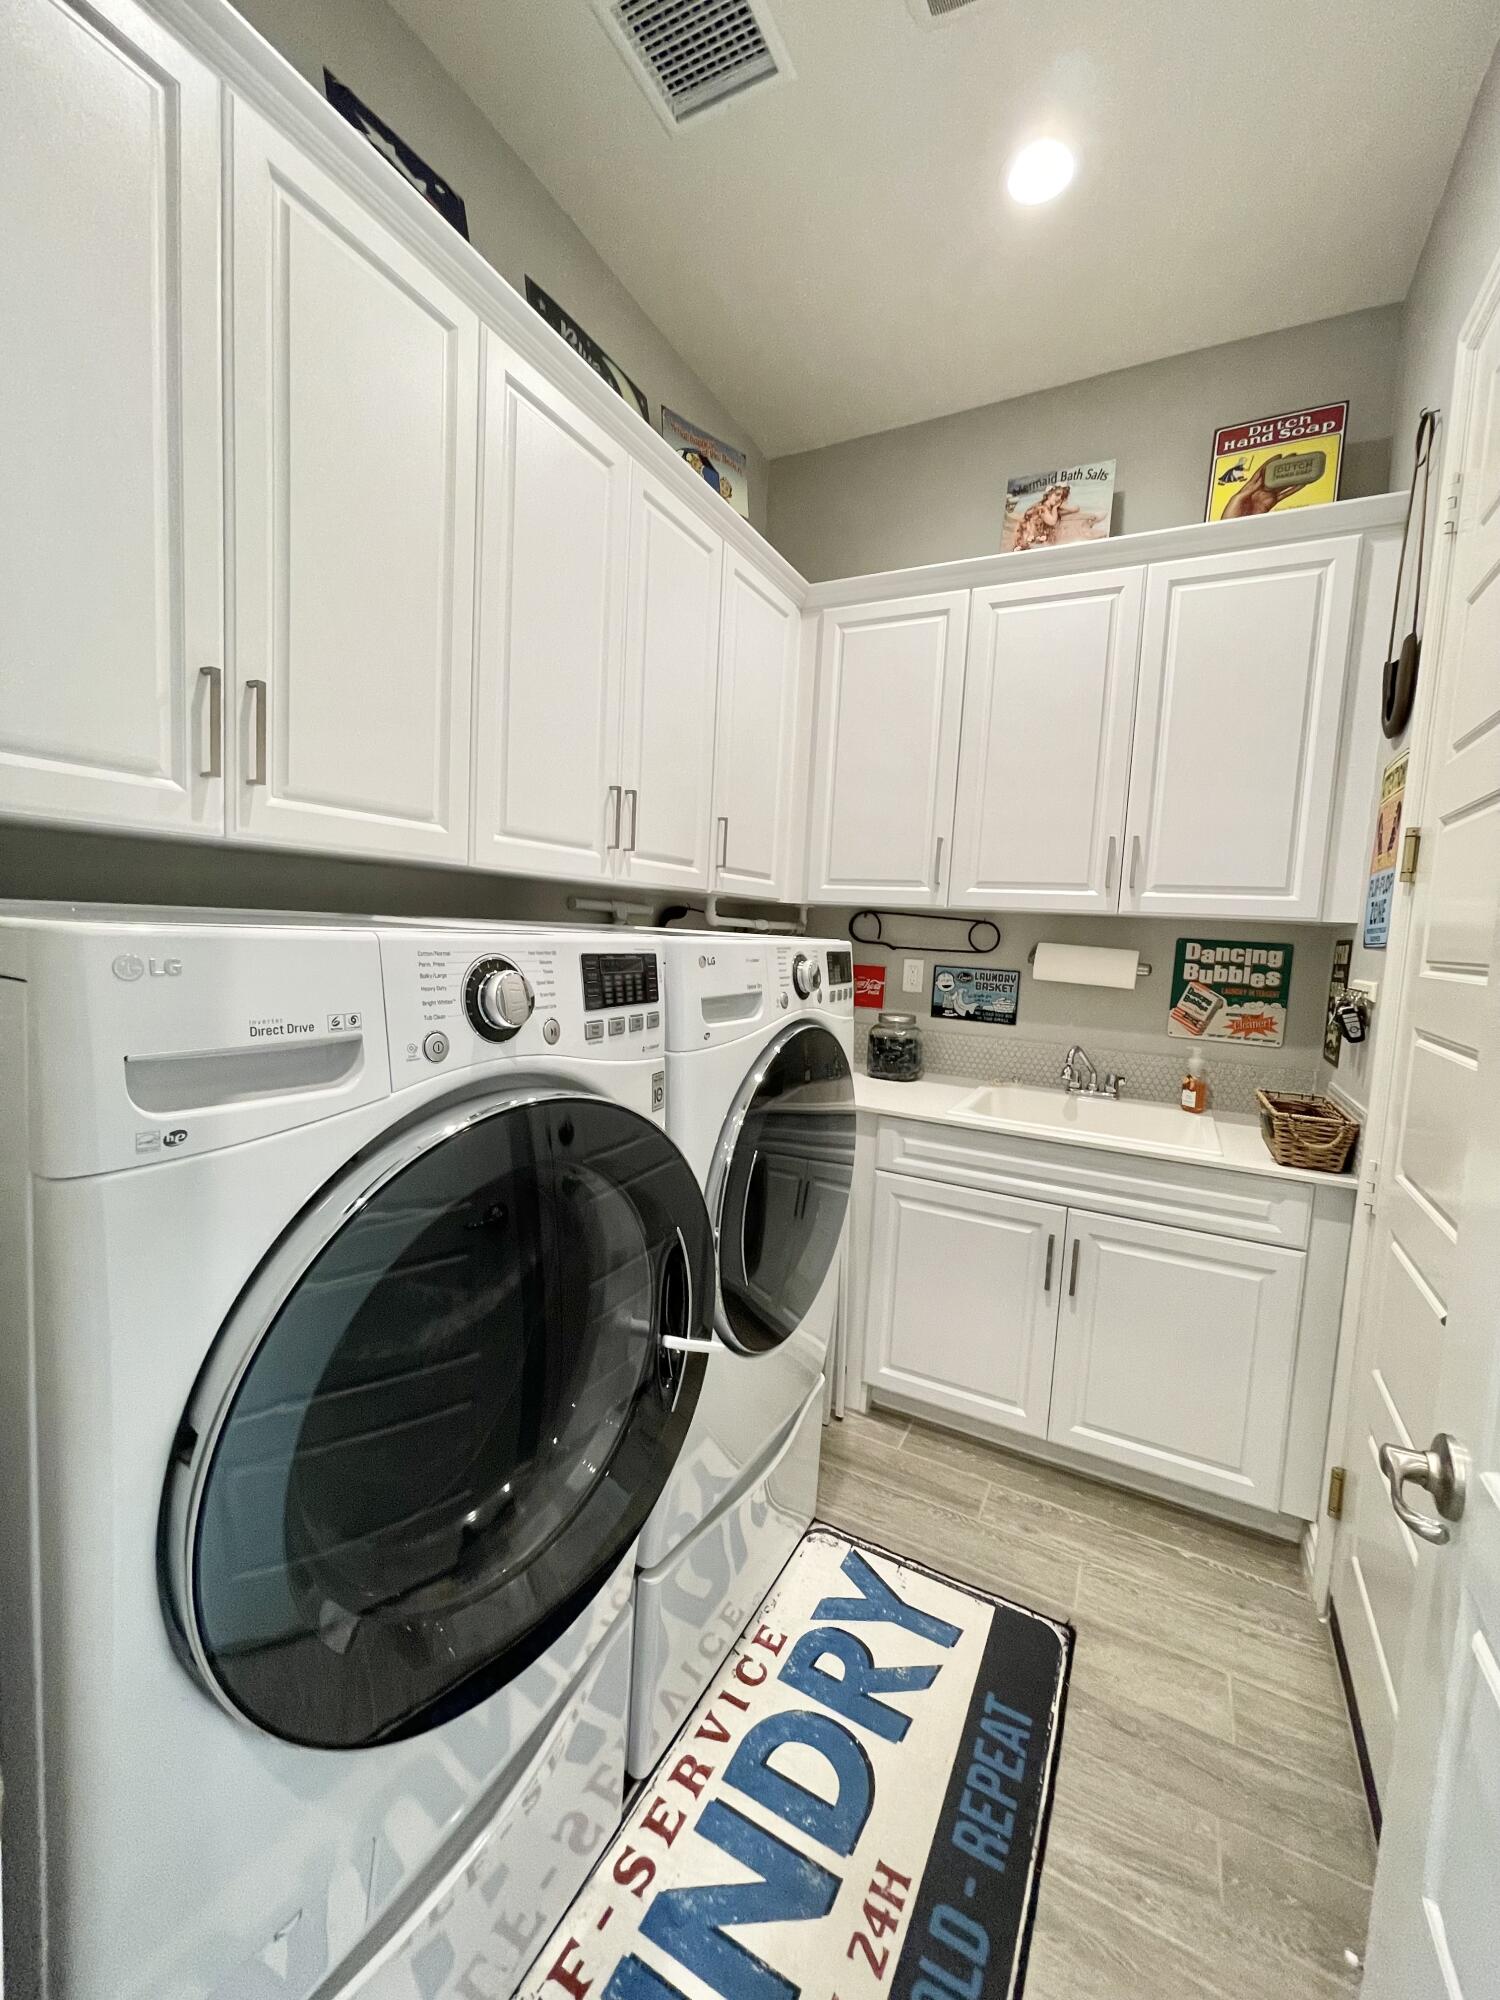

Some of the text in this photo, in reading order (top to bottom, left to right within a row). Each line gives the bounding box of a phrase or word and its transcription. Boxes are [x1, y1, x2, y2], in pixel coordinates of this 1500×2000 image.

[1223, 420, 1337, 451] Hand Soap
[1248, 415, 1312, 437] Dutch
[1060, 467, 1083, 482] Bath
[1085, 468, 1109, 482] Salts
[707, 956, 716, 966] LG
[1185, 942, 1284, 969] Dancing
[149, 957, 184, 977] LG
[975, 971, 1017, 984] LAUNDRY
[1183, 962, 1282, 989] Bubbles
[975, 981, 1015, 993] BASKET
[249, 1022, 315, 1037] Direct Drive
[951, 1691, 1033, 1872] REPEAT
[847, 1858, 912, 1981] 24H
